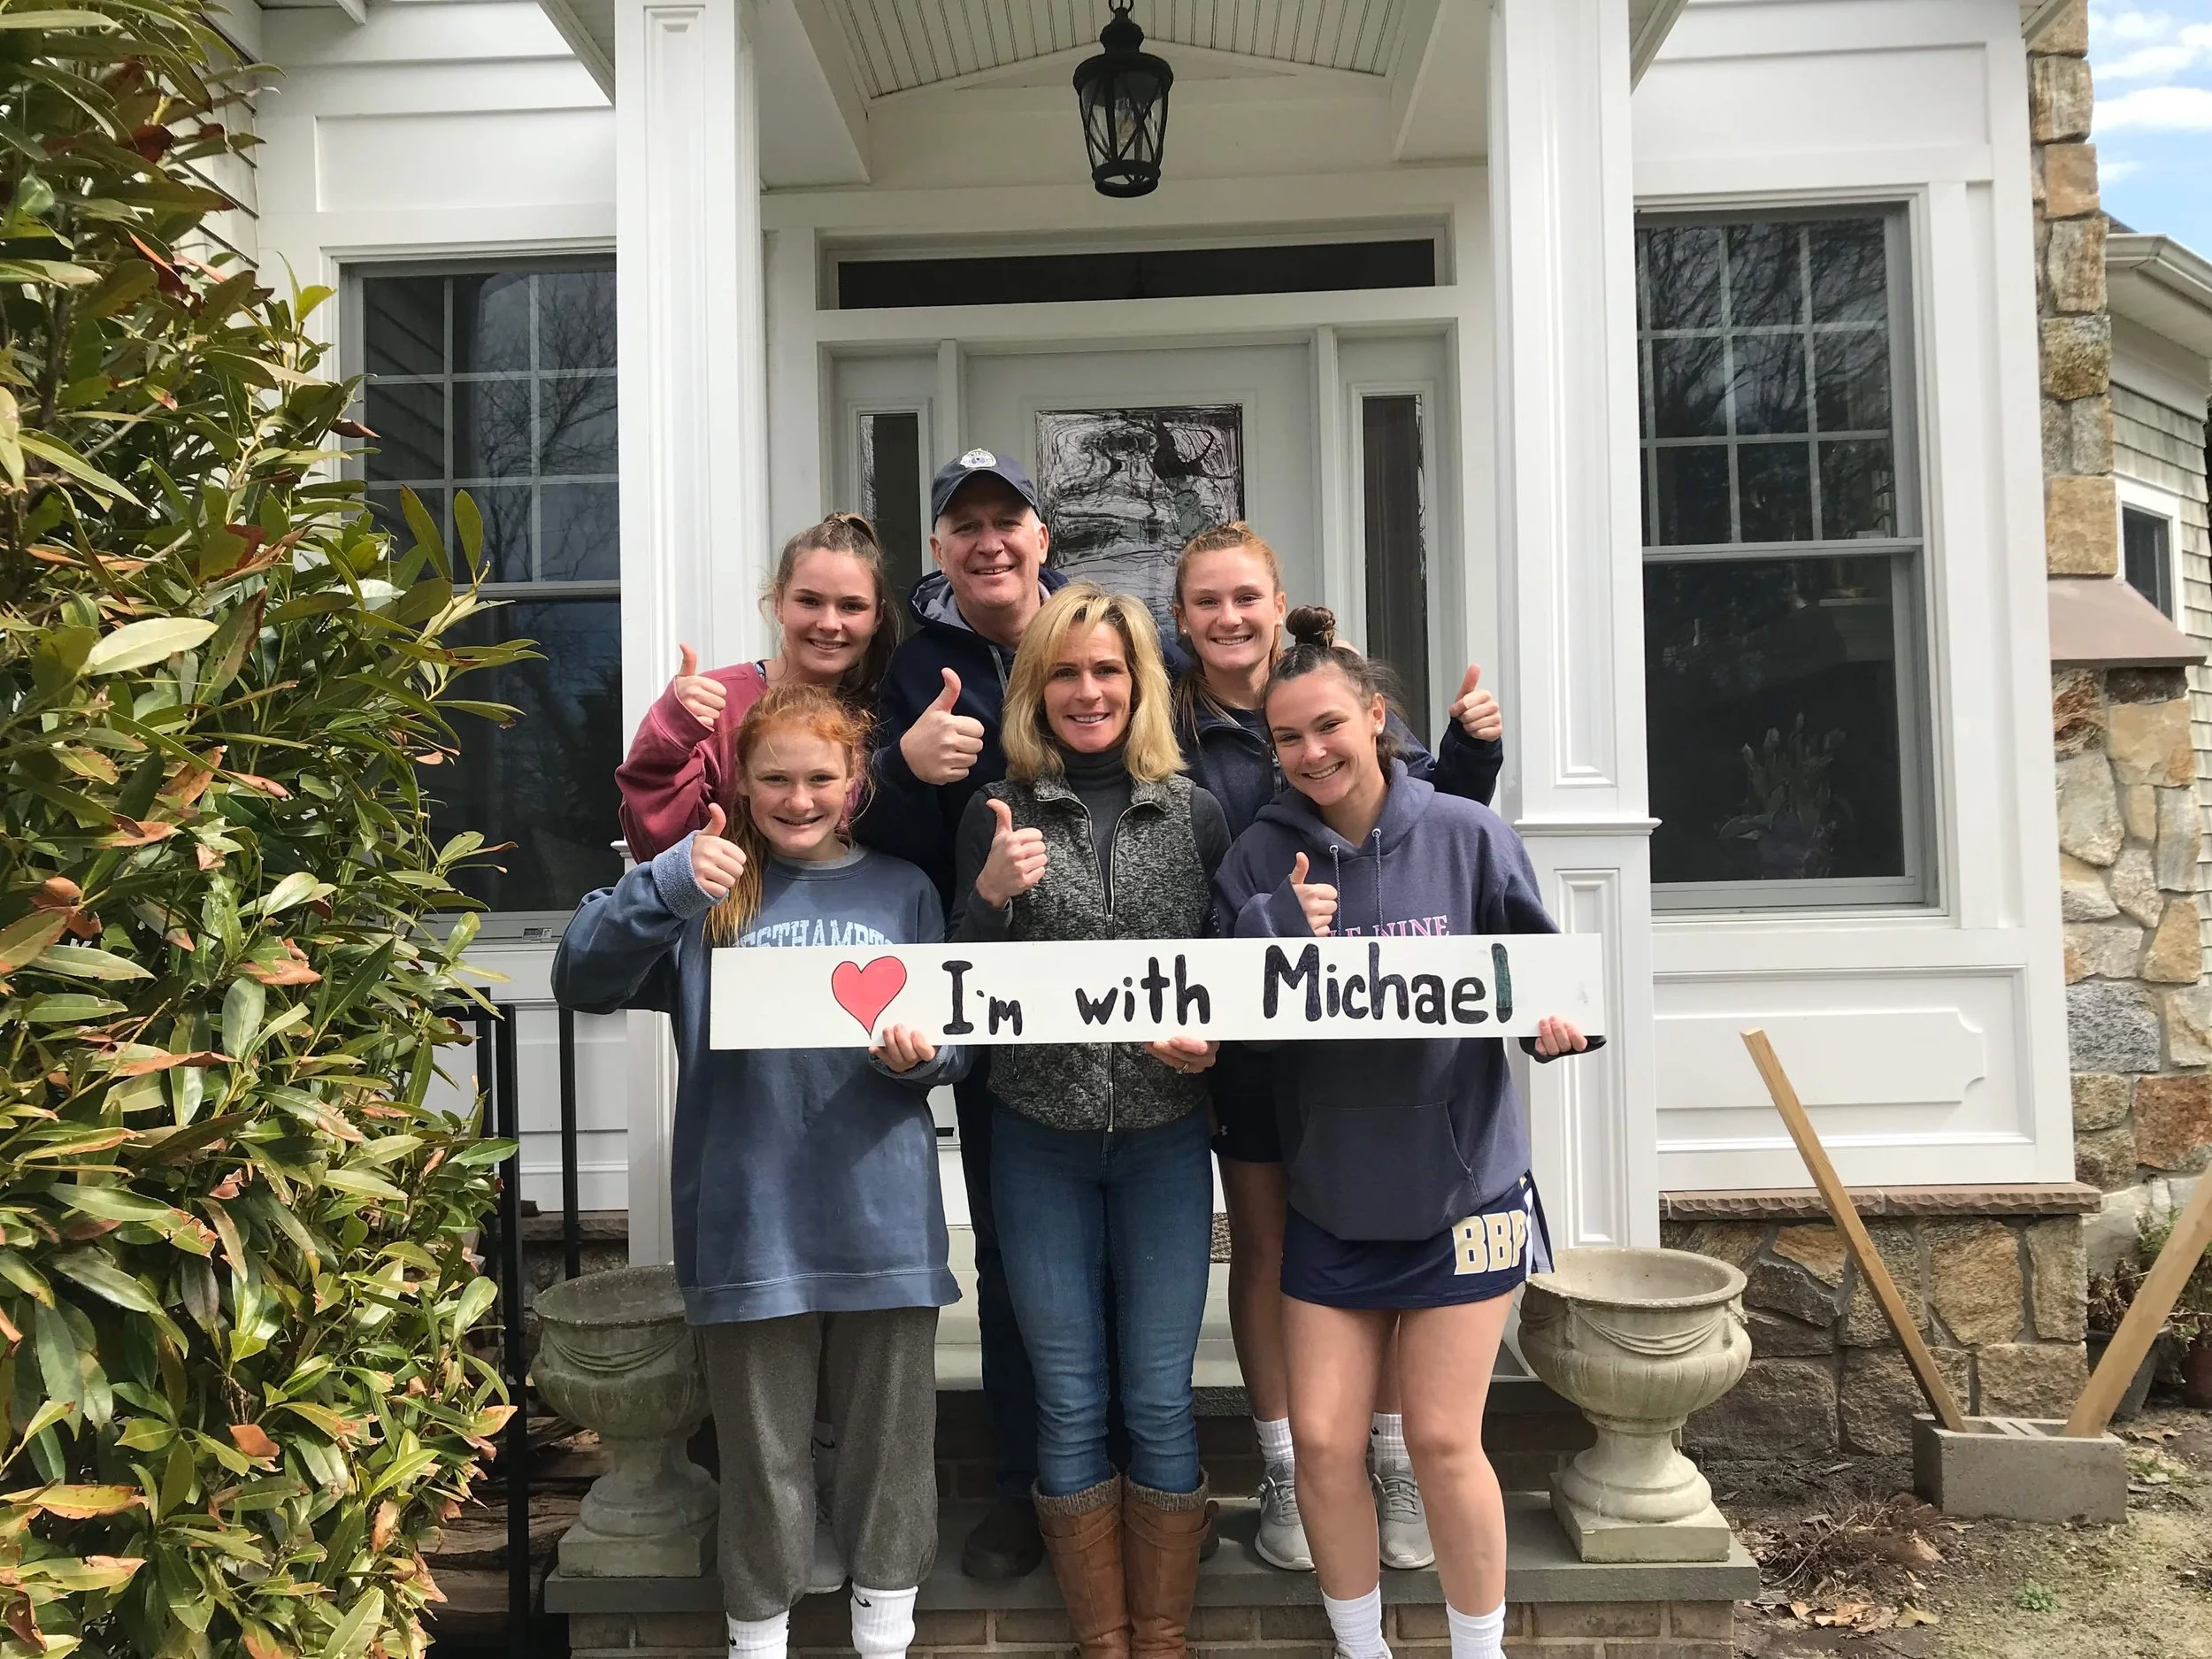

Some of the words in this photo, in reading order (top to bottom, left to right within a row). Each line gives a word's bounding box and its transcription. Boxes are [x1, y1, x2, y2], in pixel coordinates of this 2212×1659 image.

[733, 919, 894, 947] STHAMP
[941, 960, 1023, 1037] I'm
[1074, 954, 1211, 1026] with
[1263, 941, 1513, 1025] Michael
